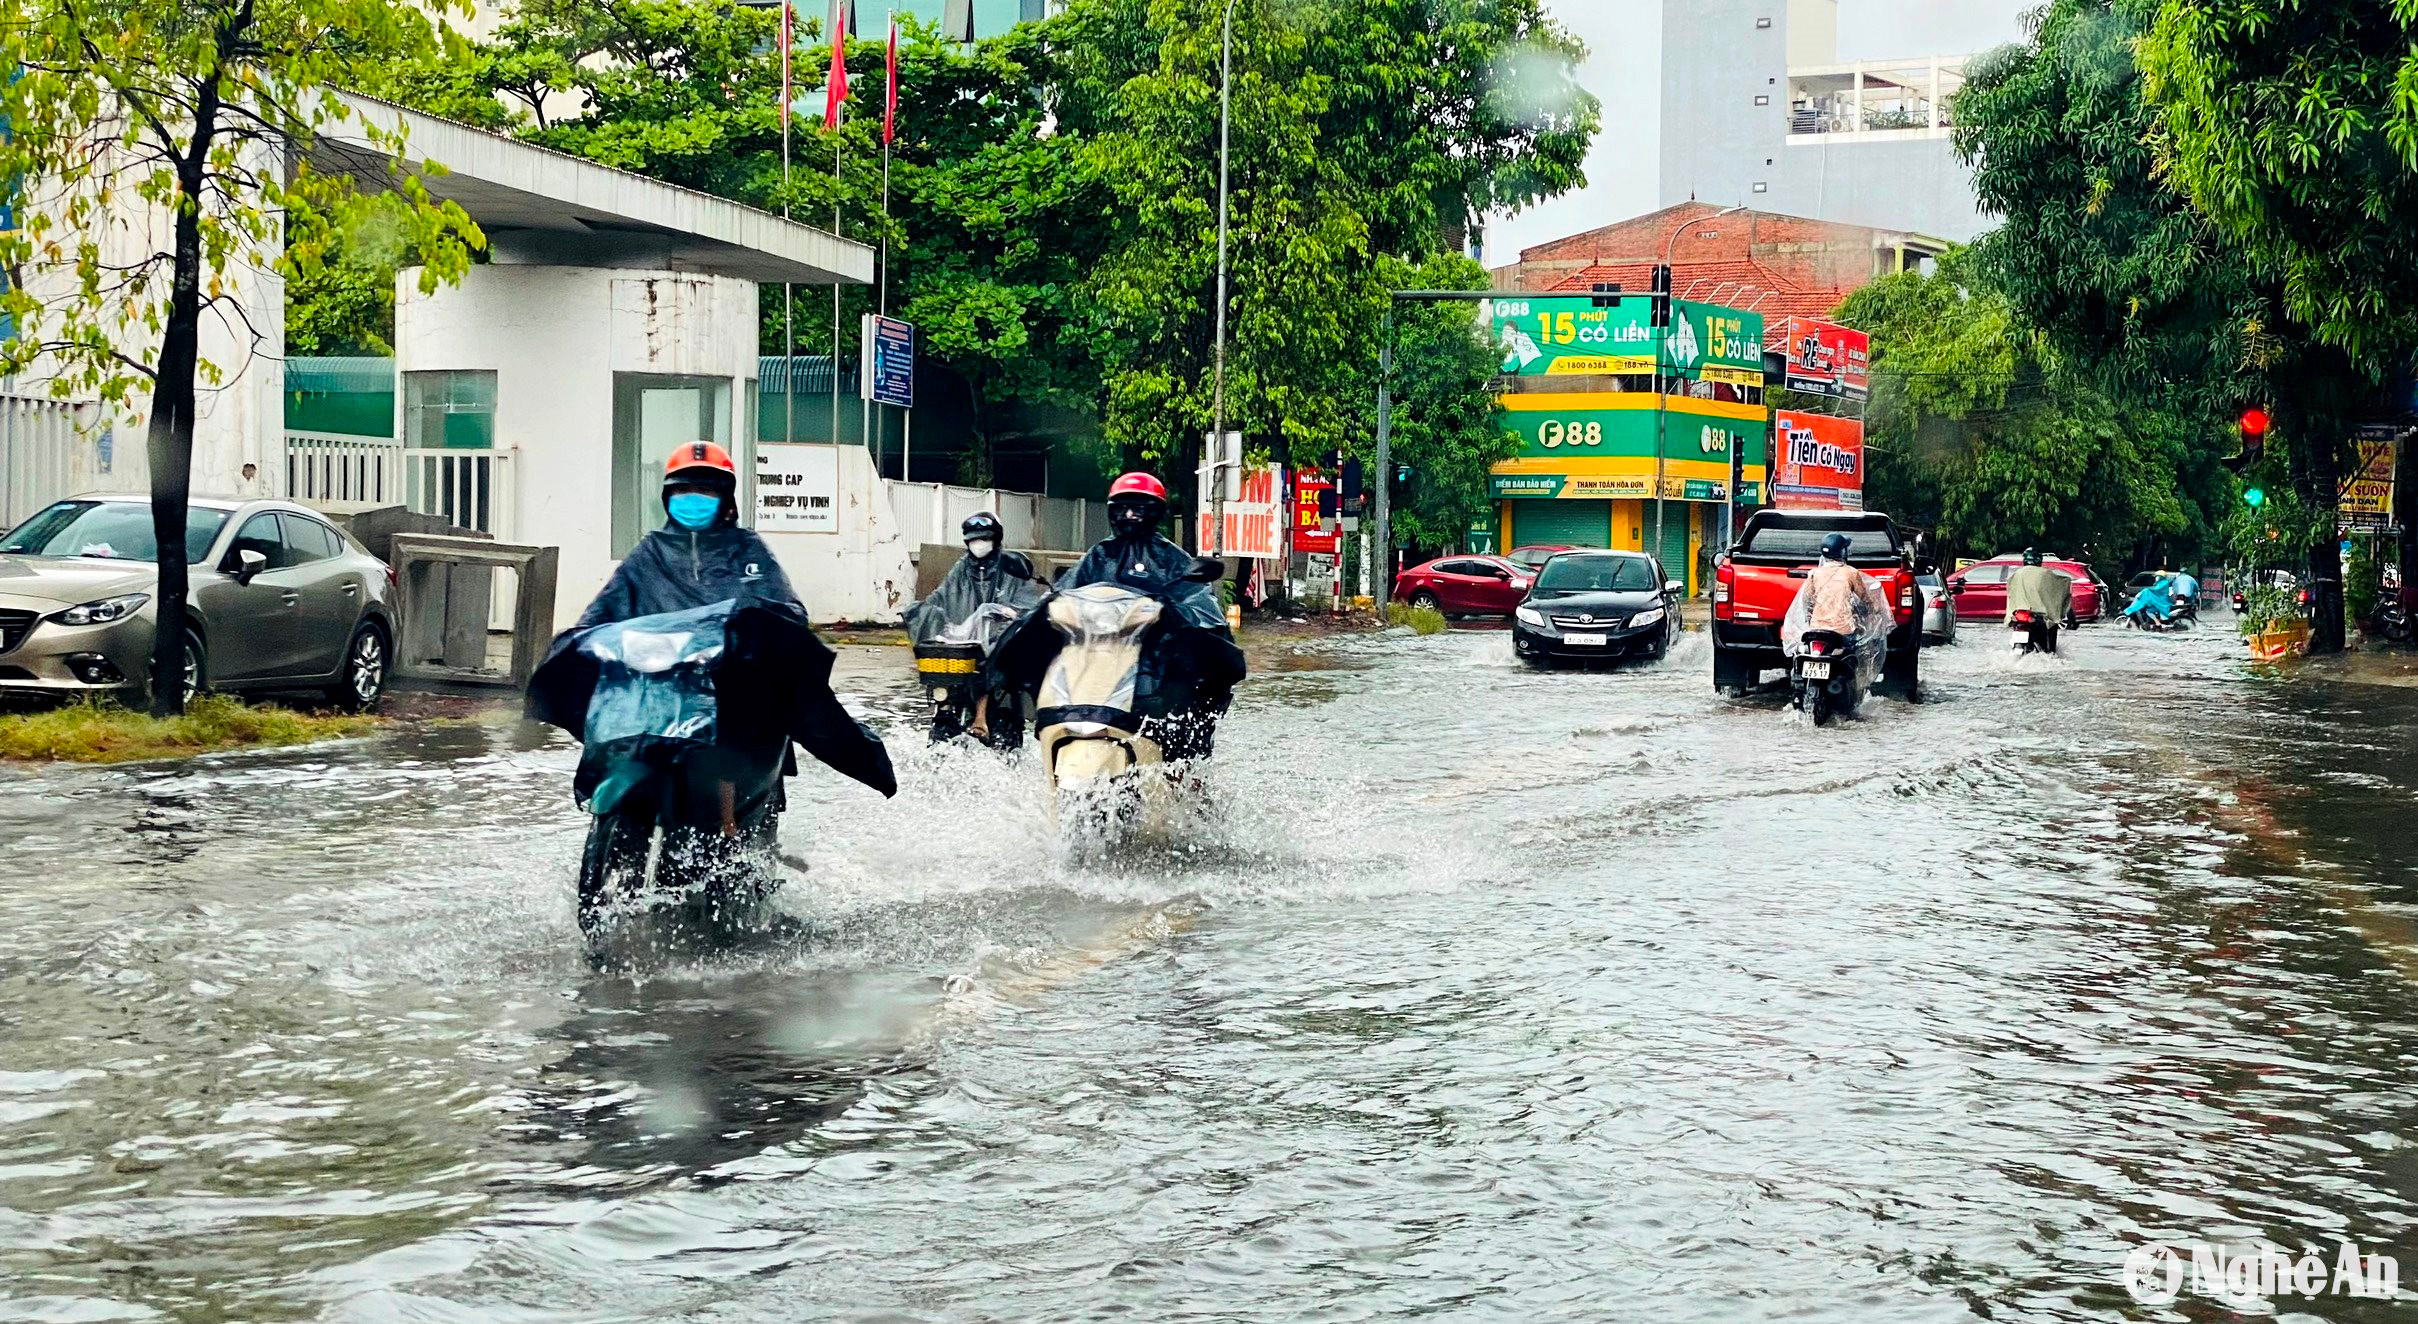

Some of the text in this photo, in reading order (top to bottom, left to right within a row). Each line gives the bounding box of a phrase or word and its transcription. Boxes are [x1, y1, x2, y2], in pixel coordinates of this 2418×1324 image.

[1538, 310, 1608, 345] 15 PHÚT
[1578, 323, 1608, 343] CÓ
[1706, 316, 1726, 358] 15
[1726, 334, 1741, 359] CÓ
[1538, 420, 1602, 448] F88
[1790, 432, 1818, 464] Tiền
[1833, 448, 1856, 473] Ngay
[1599, 480, 1615, 488] TOÁN
[1202, 504, 1277, 553] BN HUẾ
